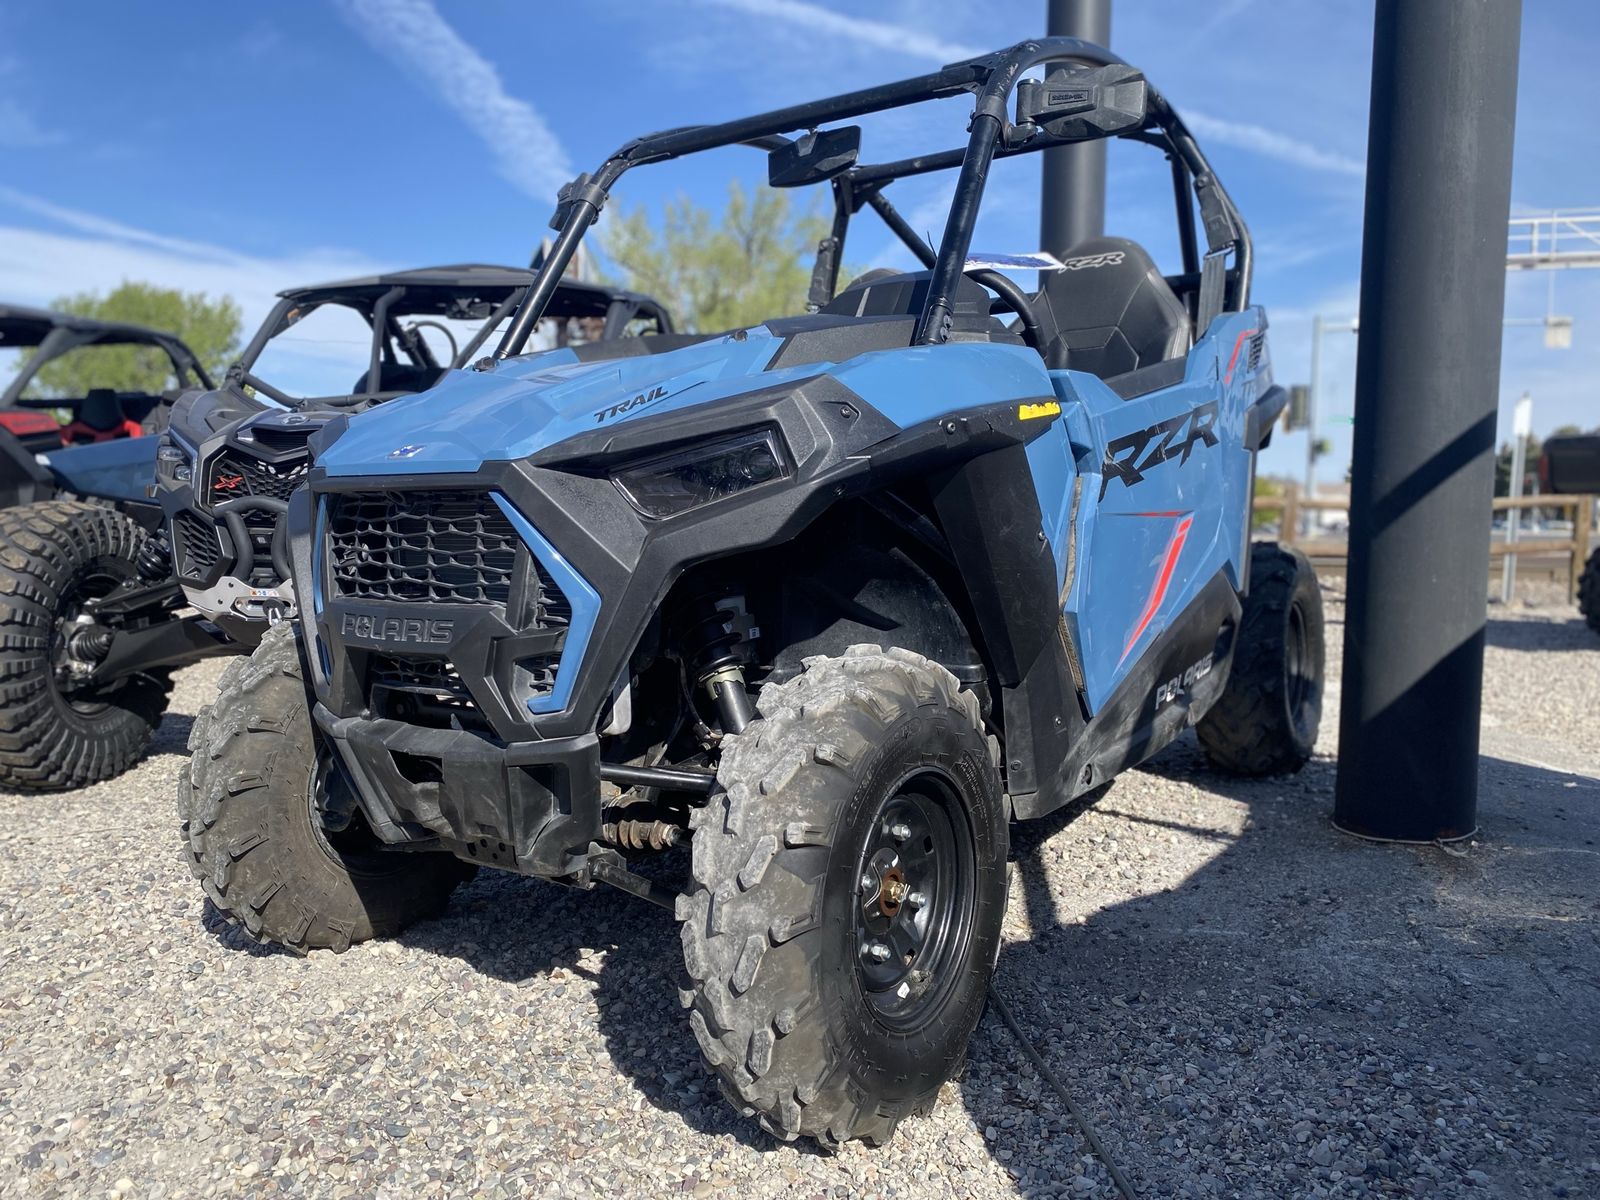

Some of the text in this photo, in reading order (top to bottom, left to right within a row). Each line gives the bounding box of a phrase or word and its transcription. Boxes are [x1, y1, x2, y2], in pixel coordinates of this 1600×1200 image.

[1057, 252, 1125, 274] RZR
[593, 386, 669, 423] TRAIL
[1098, 400, 1220, 503] RZR
[341, 612, 455, 643] POLARIS
[1155, 651, 1214, 710] POLARIS
